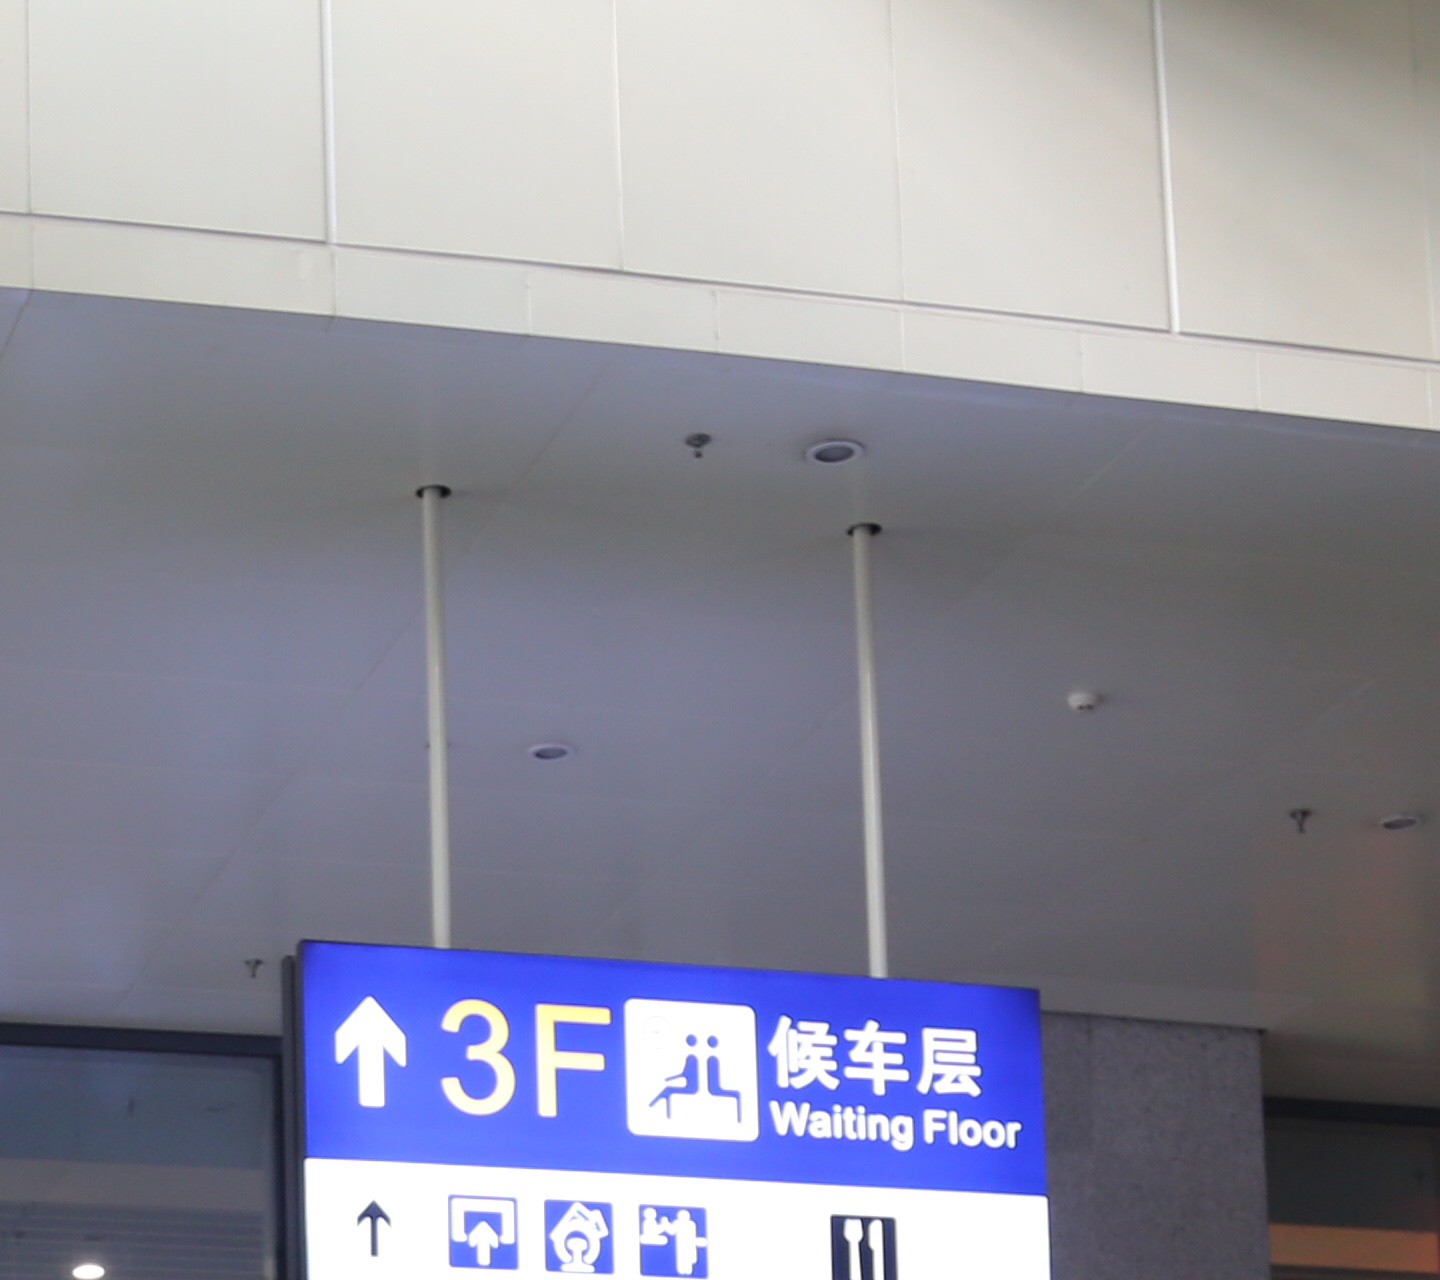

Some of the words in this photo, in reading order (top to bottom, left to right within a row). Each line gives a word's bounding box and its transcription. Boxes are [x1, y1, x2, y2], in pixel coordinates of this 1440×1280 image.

[439, 998, 612, 1118] 3F
[768, 1015, 982, 1097] 候车层
[770, 1101, 914, 1151] Waiting
[923, 1109, 1023, 1150] Floor
